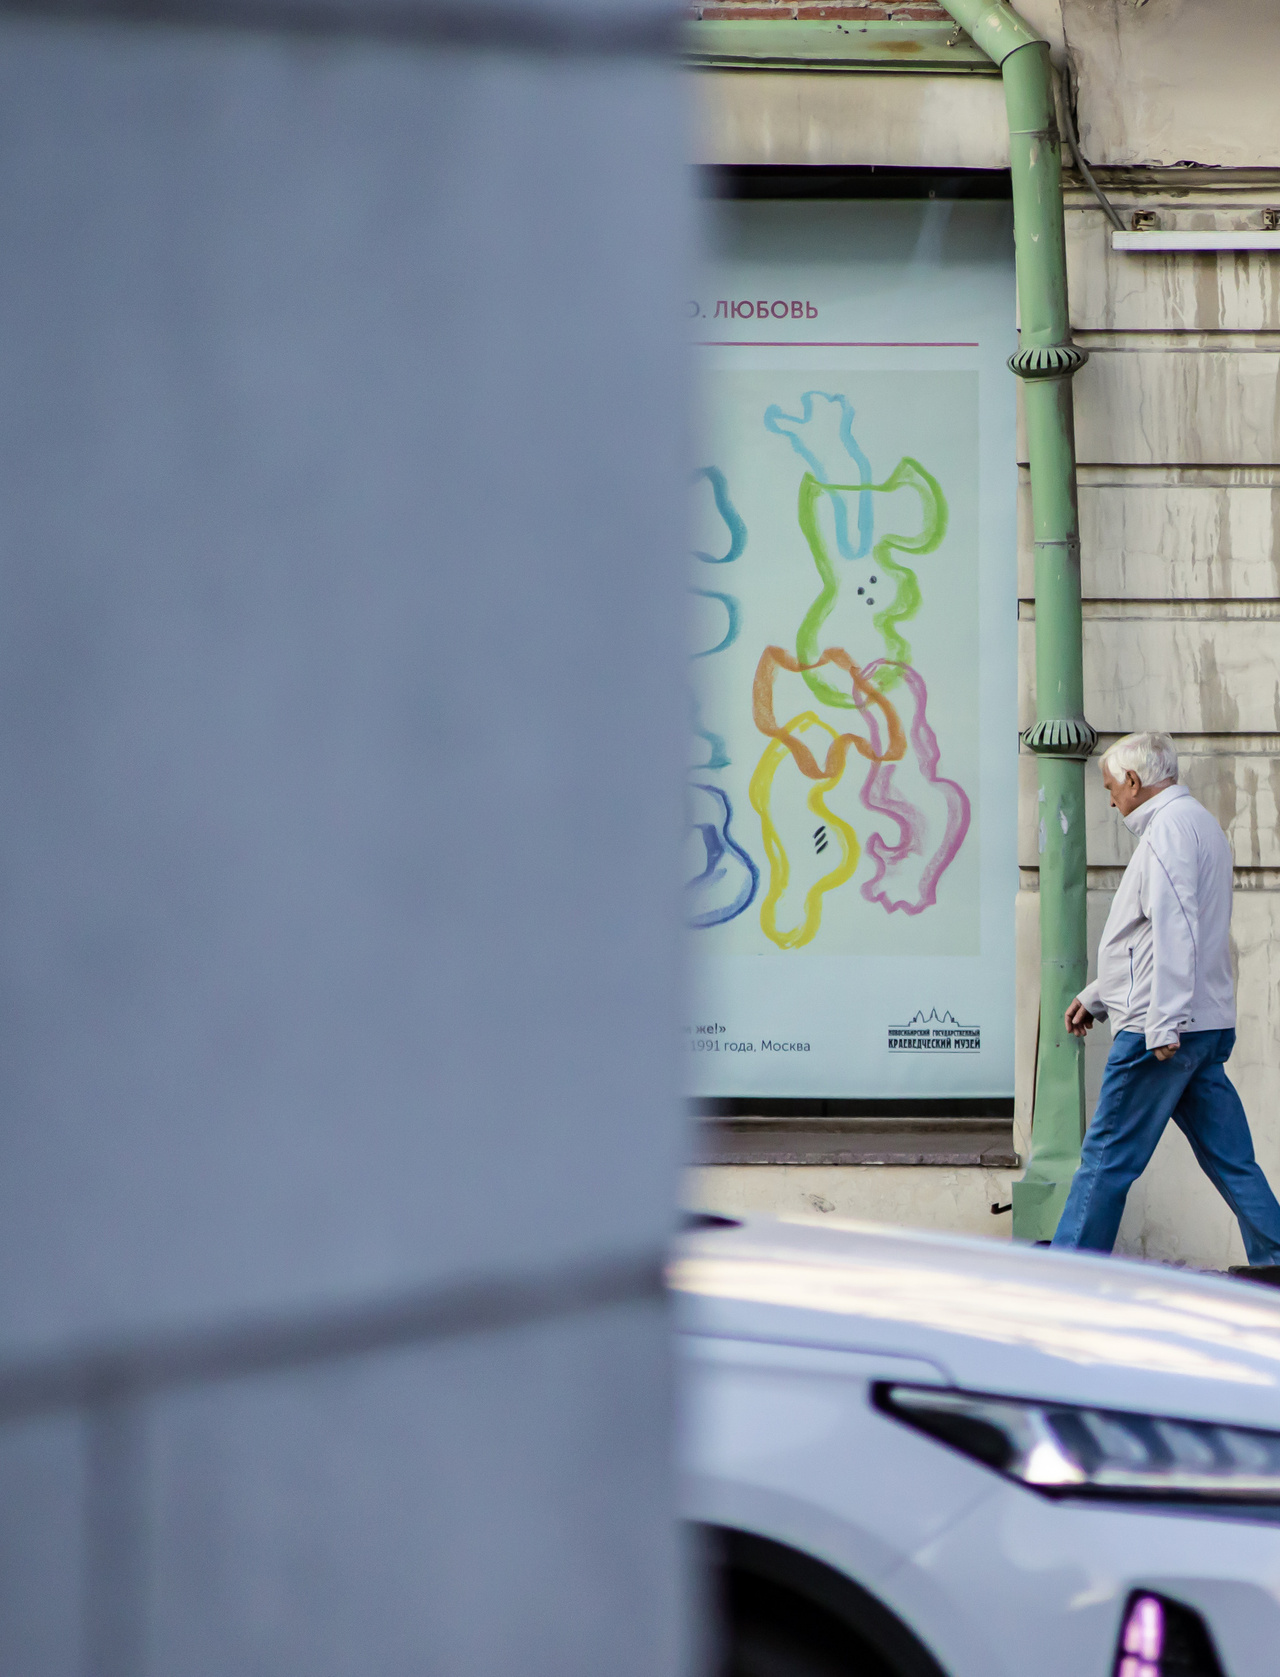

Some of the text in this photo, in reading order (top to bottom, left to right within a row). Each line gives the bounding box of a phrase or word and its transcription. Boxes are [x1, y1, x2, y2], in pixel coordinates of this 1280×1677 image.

[713, 300, 819, 319] ЛЮБОВЬ
[724, 1042, 757, 1053] года,
[761, 1040, 811, 1052] Москва
[888, 1037, 981, 1049] КРАЕВЕДЧЕСКИЙ МУЗЕЙ
